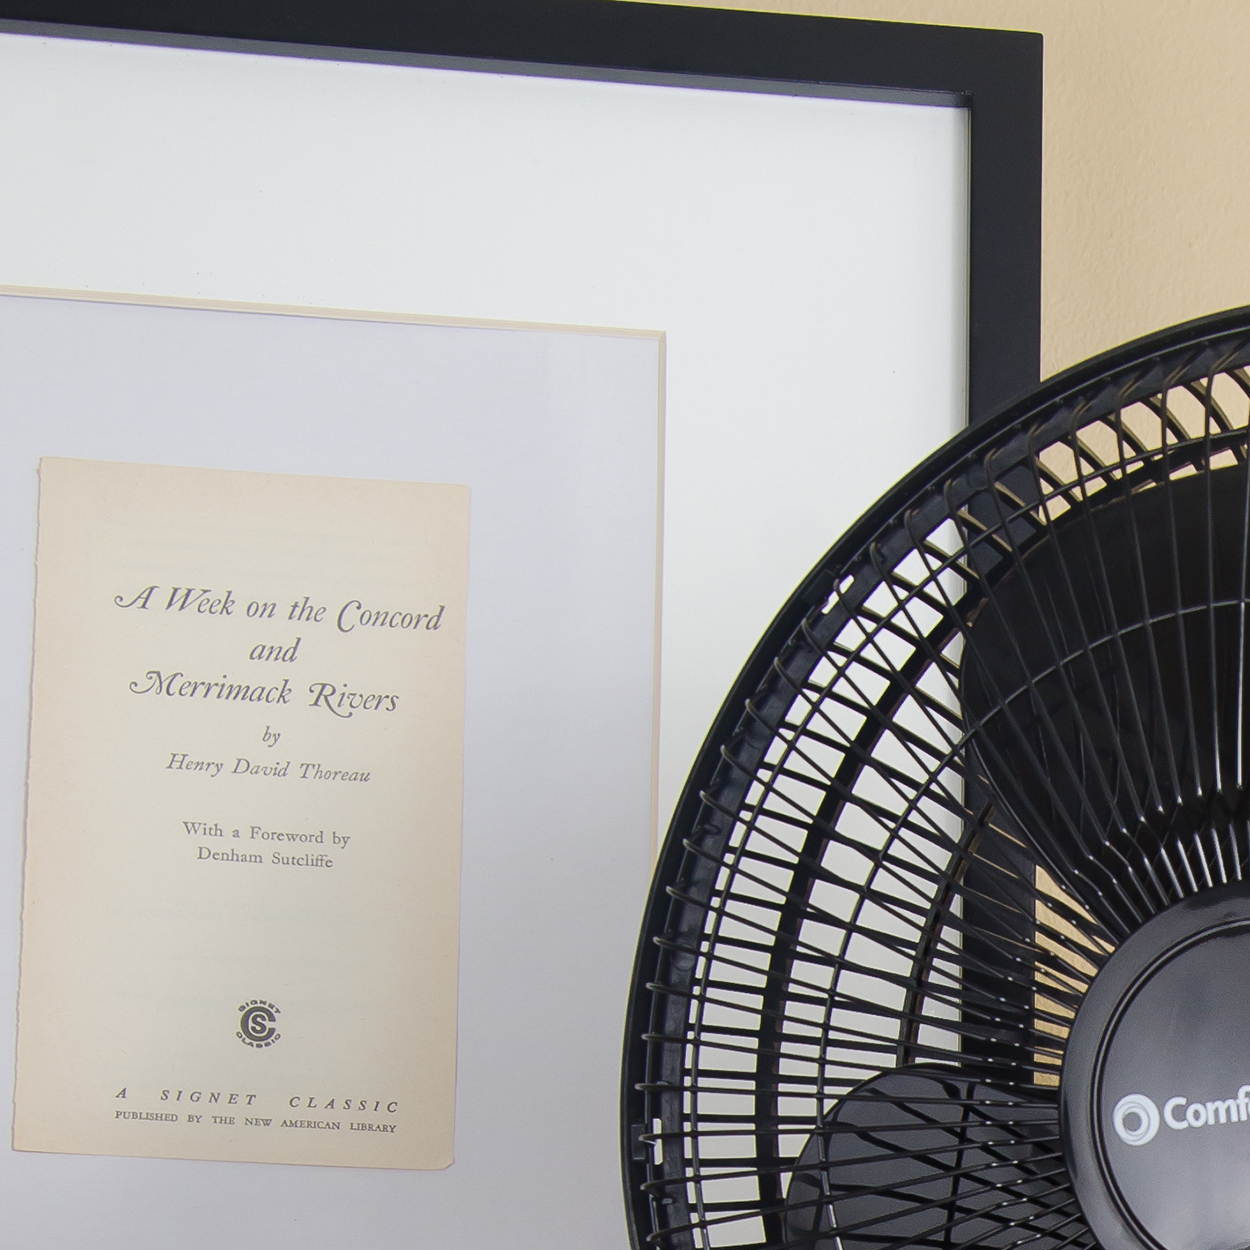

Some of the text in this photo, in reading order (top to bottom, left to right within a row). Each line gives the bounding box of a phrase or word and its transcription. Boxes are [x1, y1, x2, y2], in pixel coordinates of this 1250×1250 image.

[114, 585, 446, 633] A Week on the Concord
[249, 637, 301, 663] and
[129, 670, 400, 718] Merrimack Rivers
[262, 725, 280, 748] by
[166, 752, 371, 783] Henry David Thoreau
[182, 820, 351, 849] With a Foreword by
[196, 846, 334, 868] Denham Sutcliffe
[115, 1087, 399, 1113] A SIGNET CLASSIC
[114, 1110, 397, 1133] PUBLISHED BY THE NEW AMERICAN LIBRARY
